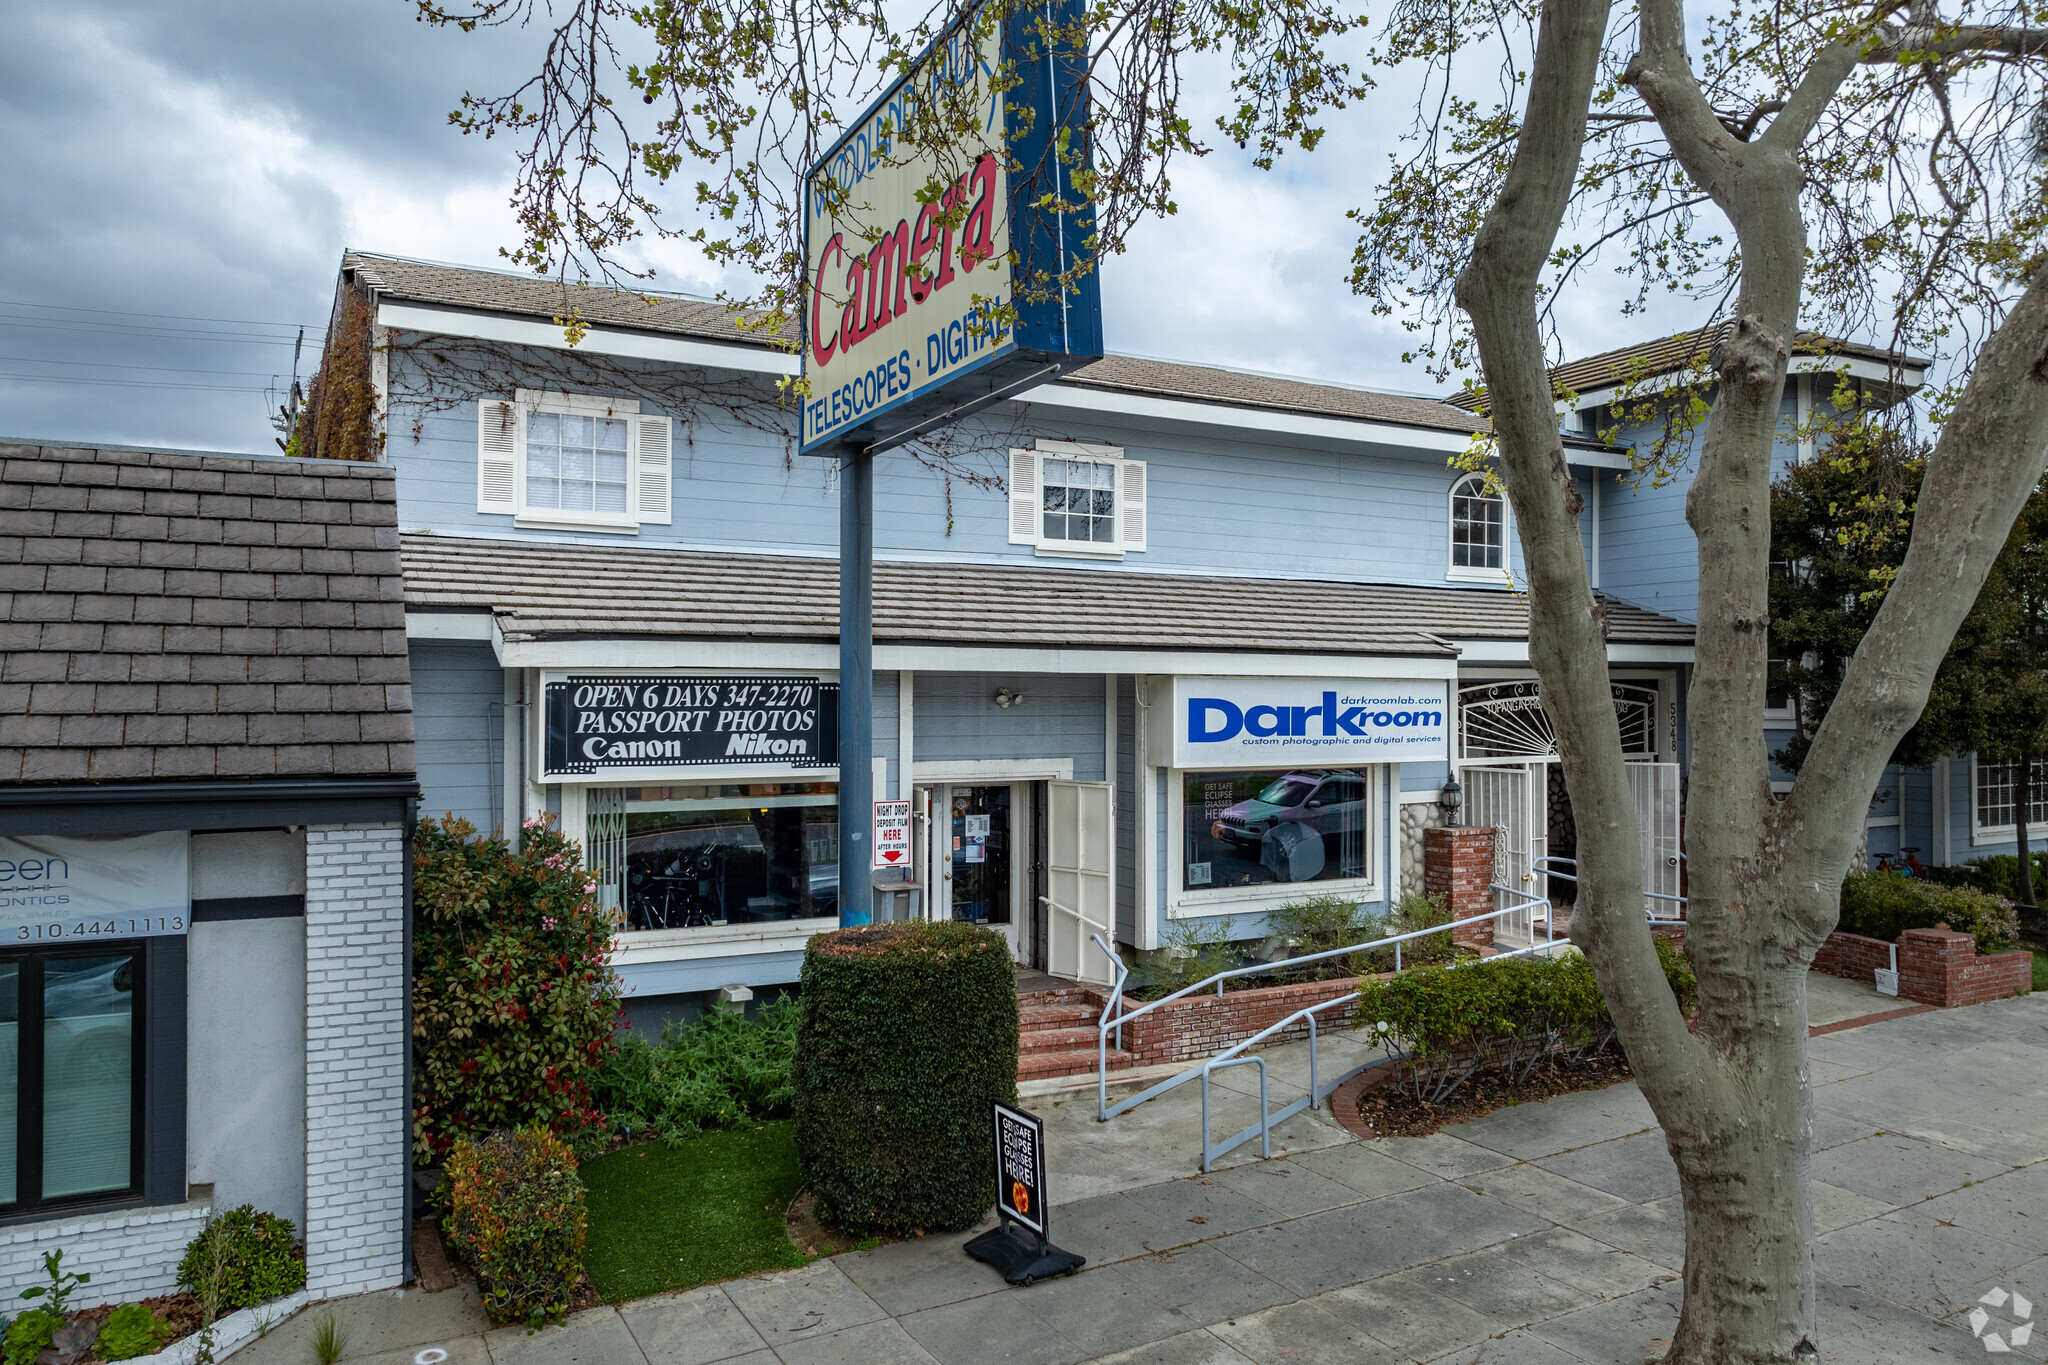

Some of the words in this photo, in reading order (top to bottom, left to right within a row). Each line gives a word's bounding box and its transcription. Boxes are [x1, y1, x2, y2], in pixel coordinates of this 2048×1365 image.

[812, 151, 997, 367] Camera
[807, 350, 911, 438] TELESCOPES
[927, 295, 1010, 376] DIGITAL
[574, 684, 640, 708] OPEN
[643, 685, 659, 708] 6
[662, 685, 720, 707] DAYS
[723, 685, 813, 707] 347-2270
[1341, 695, 1442, 705] darkroomlab.com
[575, 711, 710, 734] PASSPORT
[714, 709, 816, 732] PHOTOS
[582, 736, 681, 760] Canon
[725, 733, 807, 756] Nikon
[1282, 736, 1350, 747] photographic
[1352, 737, 1372, 745] and
[1374, 735, 1404, 746] digital
[1406, 735, 1442, 744] services
[1204, 783, 1217, 791] GET
[1218, 782, 1233, 790] SAFE
[1204, 791, 1233, 800] ECLIPSE
[1204, 800, 1233, 808] GLASSES
[877, 805, 893, 816] NIGHT
[895, 804, 908, 816] DROP
[877, 818, 896, 828] DEPOSIT
[898, 818, 908, 827] FILM
[883, 829, 902, 841] HERE
[17, 916, 184, 940] 310.444.1113
[1015, 1124, 1032, 1141] SAFE
[1005, 1157, 1034, 1188] HERE!
